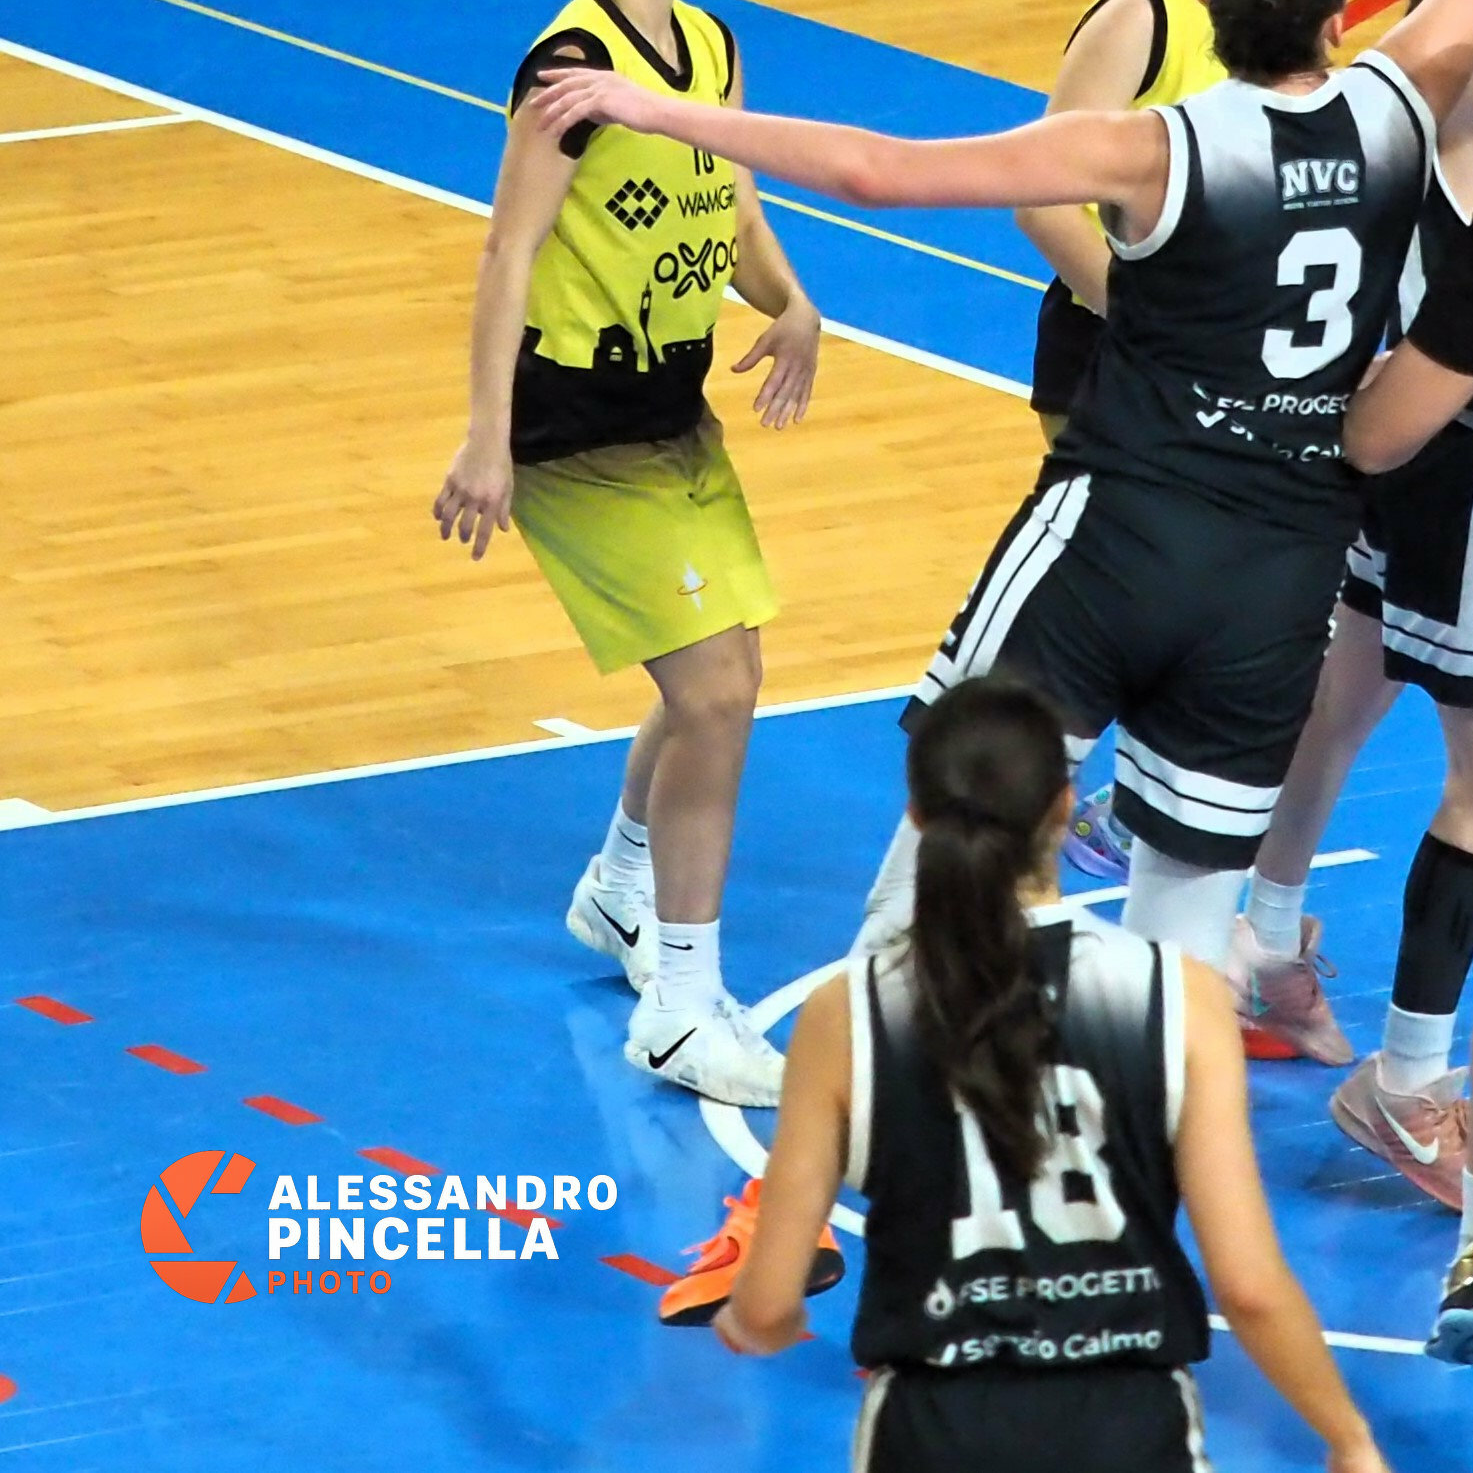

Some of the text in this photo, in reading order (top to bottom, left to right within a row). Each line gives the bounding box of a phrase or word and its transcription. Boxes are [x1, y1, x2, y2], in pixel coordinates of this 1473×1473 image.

[1280, 159, 1359, 200] NVC
[1261, 227, 1363, 379] 3
[951, 1064, 1128, 1260] 18
[1063, 1329, 1162, 1359] Calmo
